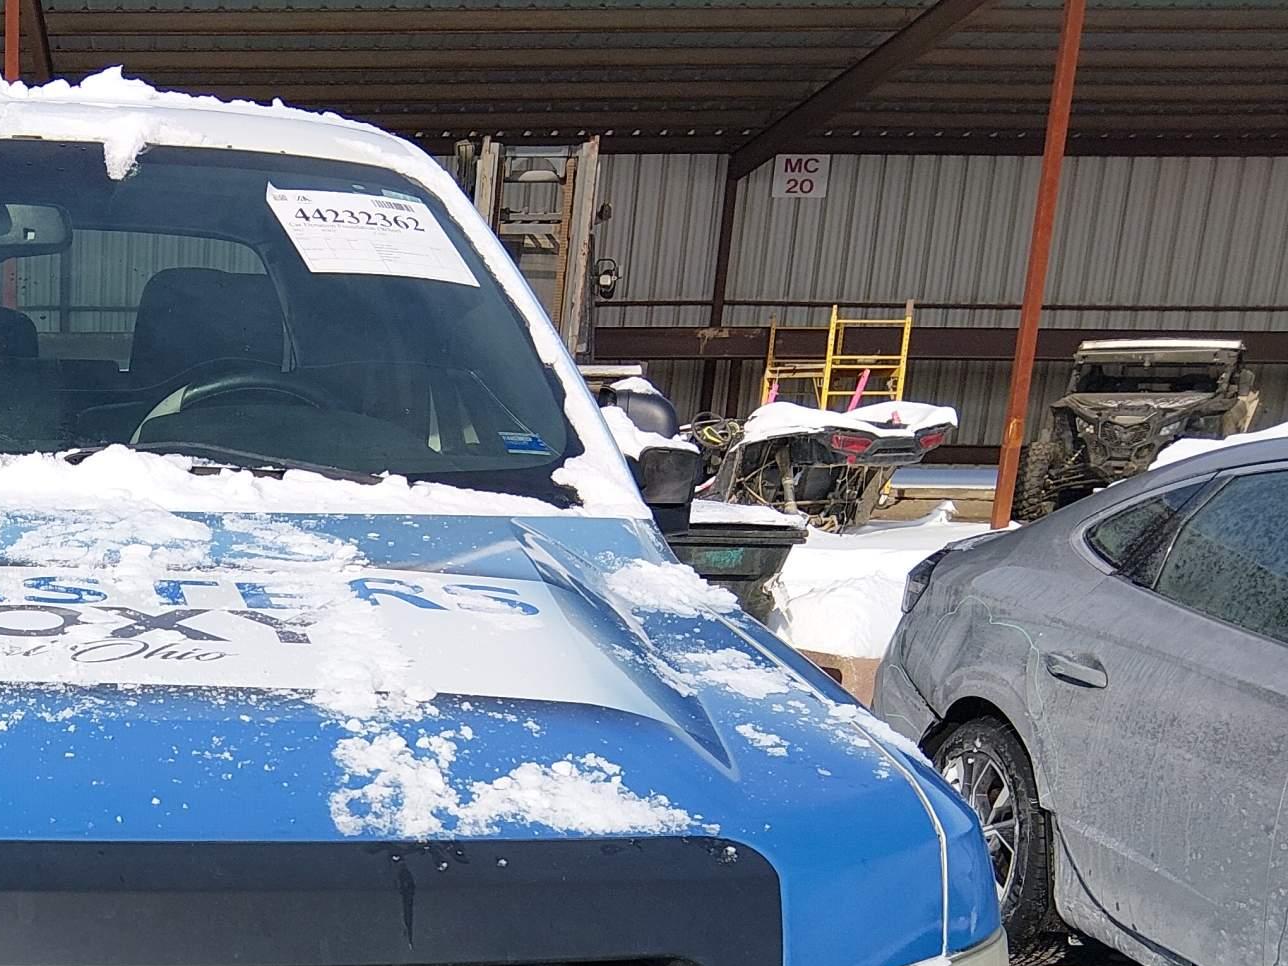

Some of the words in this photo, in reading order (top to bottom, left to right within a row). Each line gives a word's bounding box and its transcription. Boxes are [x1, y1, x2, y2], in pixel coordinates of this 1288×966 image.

[784, 158, 820, 173] MC
[785, 178, 814, 194] 20
[294, 207, 425, 232] 44232362
[70, 638, 238, 663] Ohio
